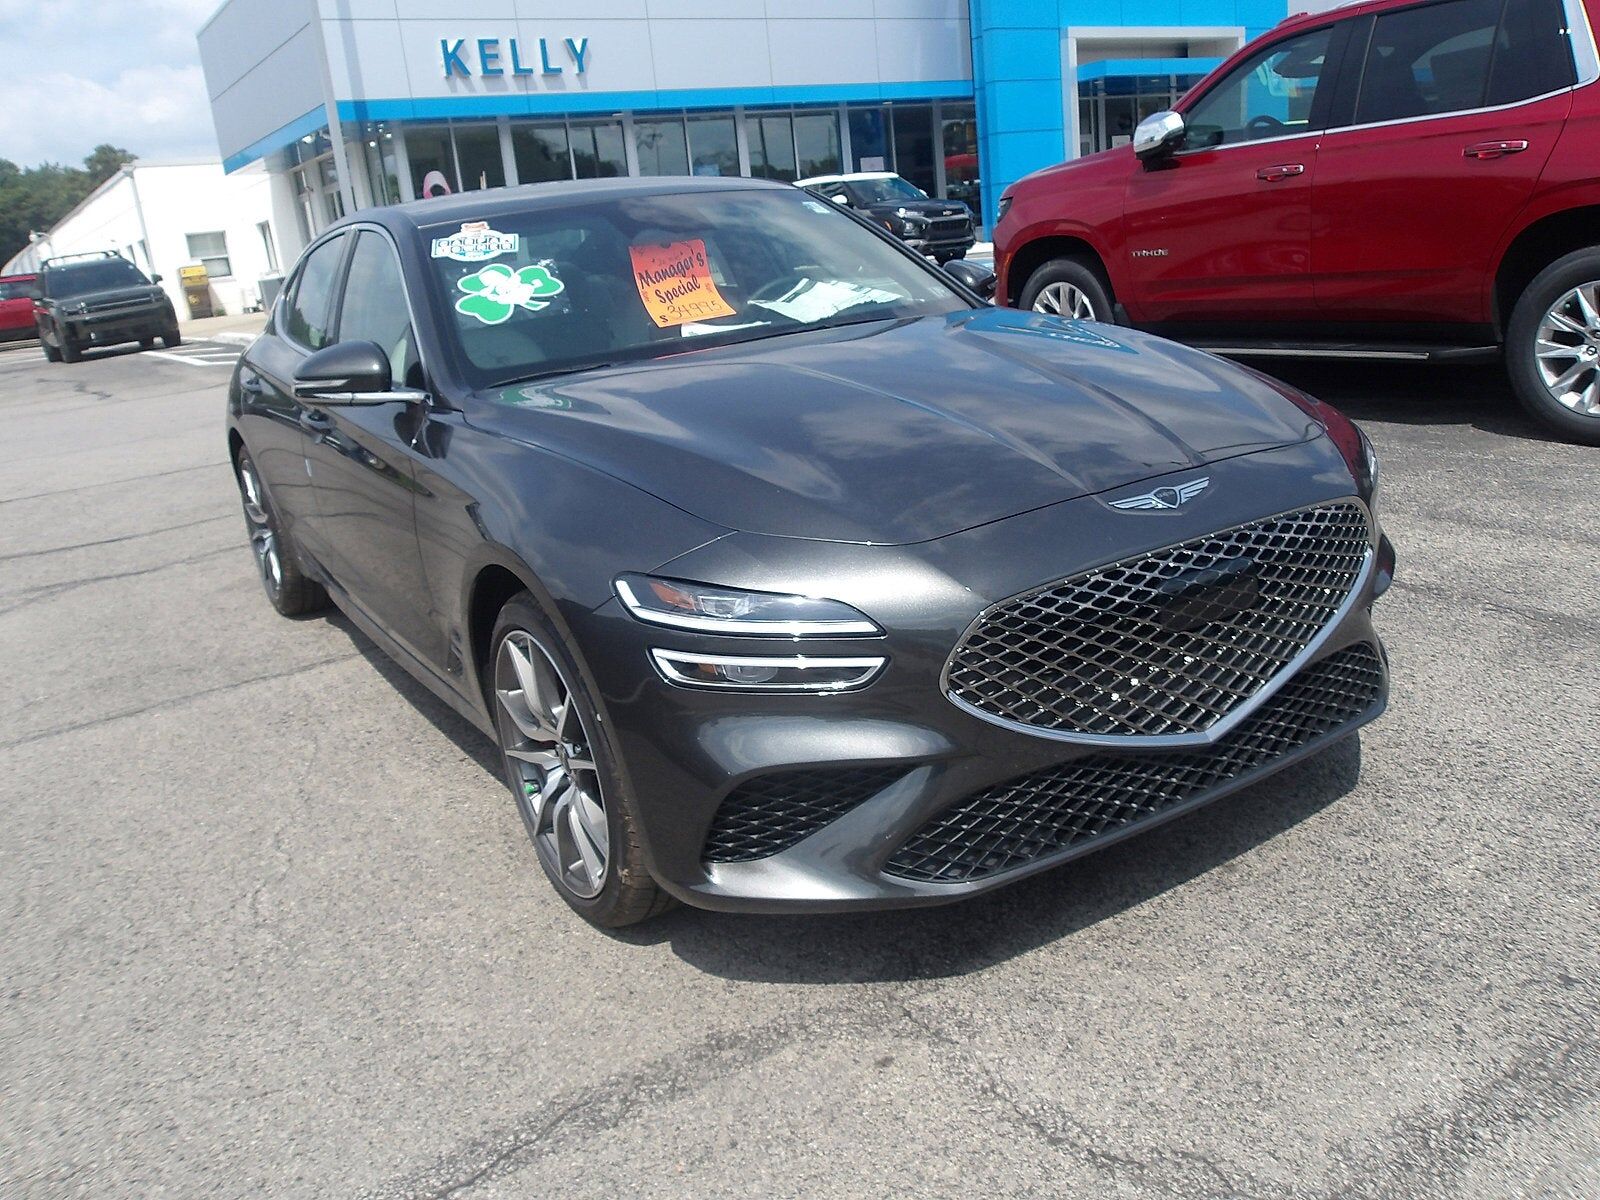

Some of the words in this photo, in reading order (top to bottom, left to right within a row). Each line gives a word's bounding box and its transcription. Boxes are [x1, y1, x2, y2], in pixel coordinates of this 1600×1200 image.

[440, 38, 588, 77] KELLY
[638, 248, 705, 290] Manager's
[654, 274, 701, 304] Special
